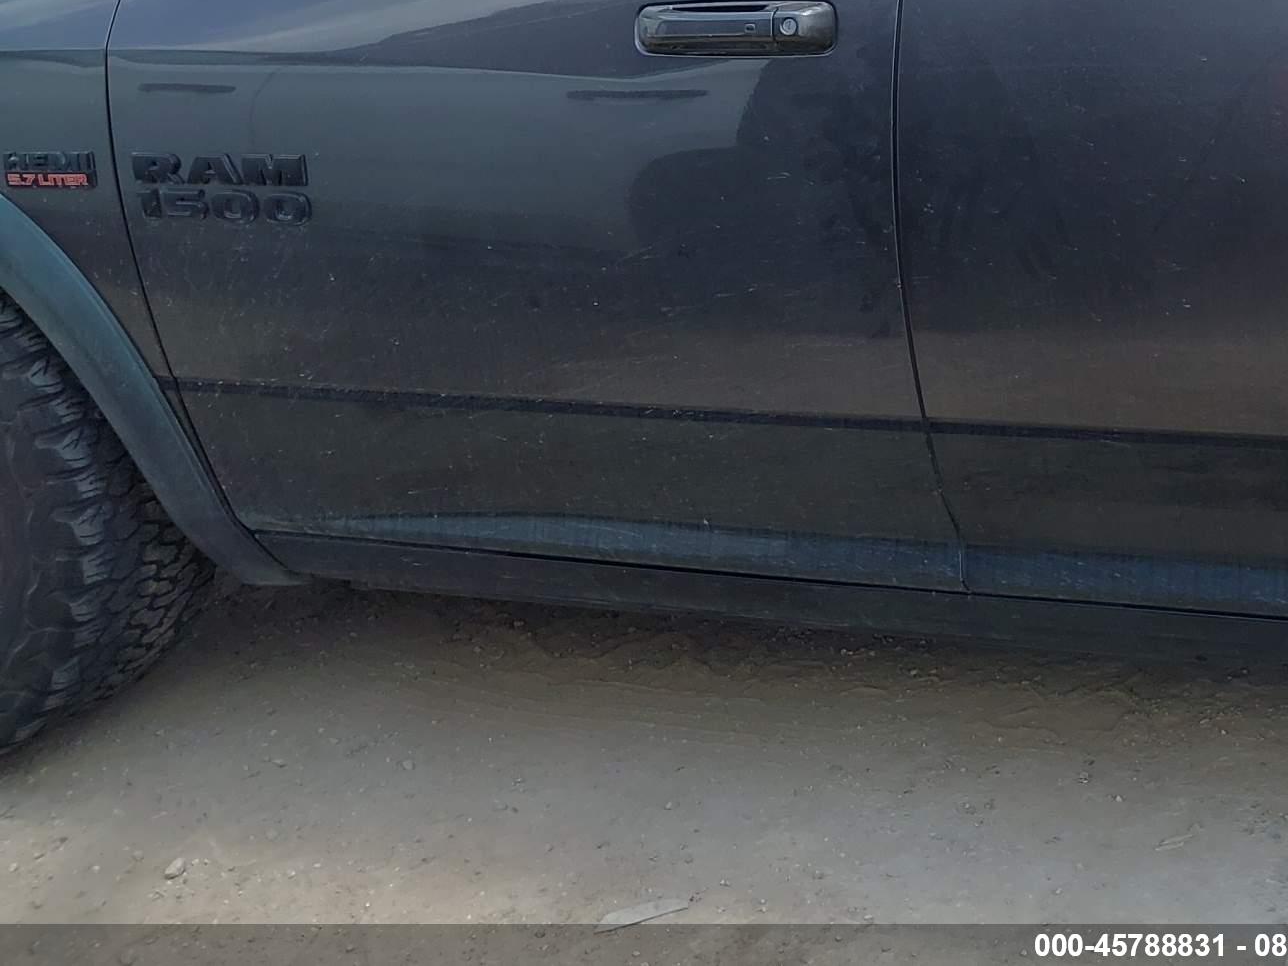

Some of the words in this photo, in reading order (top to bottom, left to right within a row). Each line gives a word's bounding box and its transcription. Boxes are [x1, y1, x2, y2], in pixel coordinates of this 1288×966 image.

[7, 173, 36, 186] 5.7
[38, 173, 88, 186] LITER
[132, 151, 309, 185] RAM
[138, 189, 312, 225] 1500
